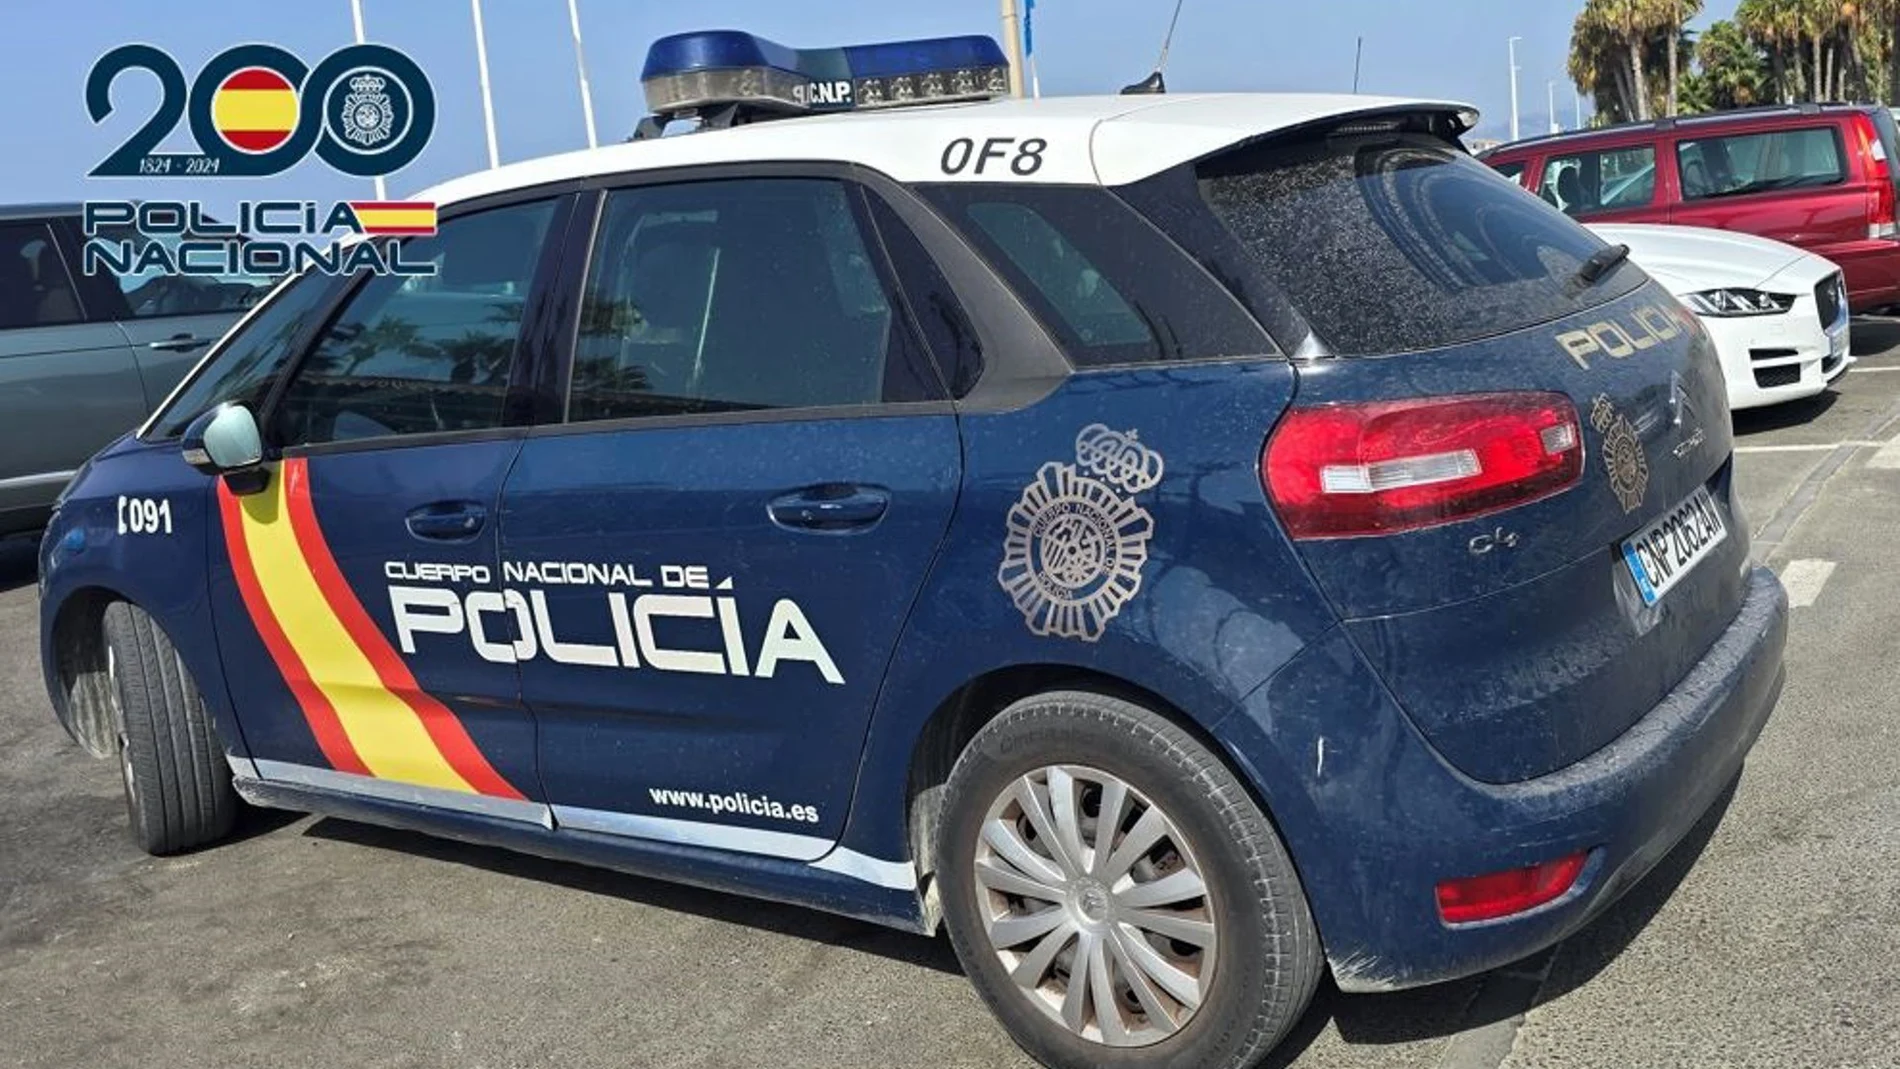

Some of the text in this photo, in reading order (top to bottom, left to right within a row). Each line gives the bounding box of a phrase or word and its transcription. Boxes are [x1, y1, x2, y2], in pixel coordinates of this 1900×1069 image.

[129, 498, 173, 533] 091
[1469, 526, 1520, 555] C4
[385, 561, 710, 588] CUERPO NACIONAL DE
[387, 576, 847, 685] POLICÍA
[649, 787, 820, 824] www.policia.es
